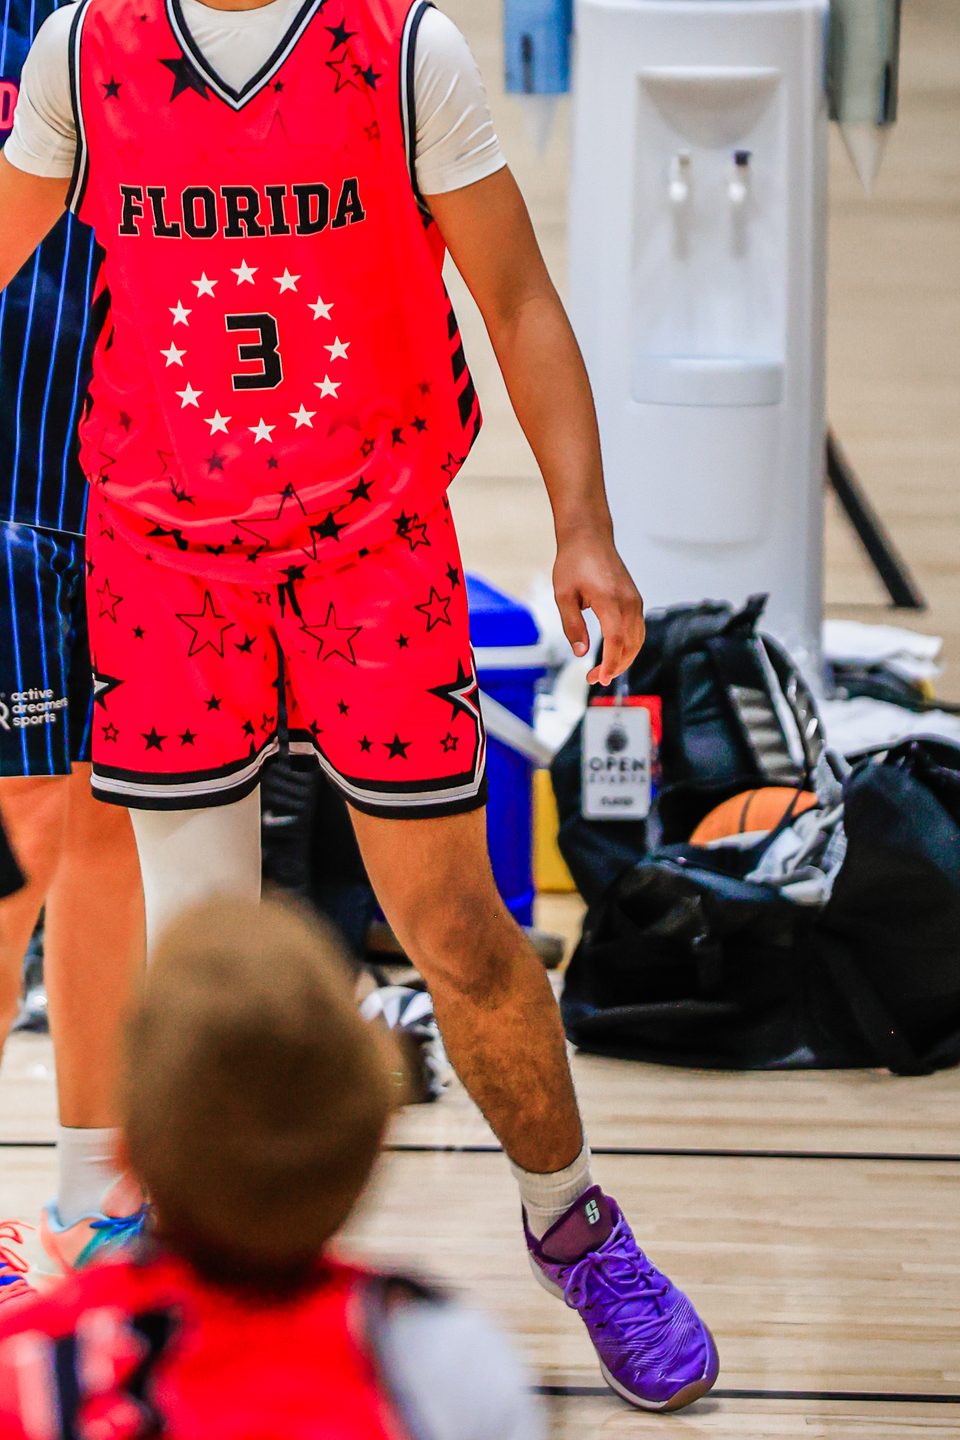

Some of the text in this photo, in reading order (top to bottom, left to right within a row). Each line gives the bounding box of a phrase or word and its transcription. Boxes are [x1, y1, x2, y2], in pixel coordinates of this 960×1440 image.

[118, 177, 366, 240] FLORIDA
[224, 312, 284, 392] 3
[11, 687, 54, 702] active
[12, 711, 57, 729] sports
[589, 756, 646, 772] OPEN
